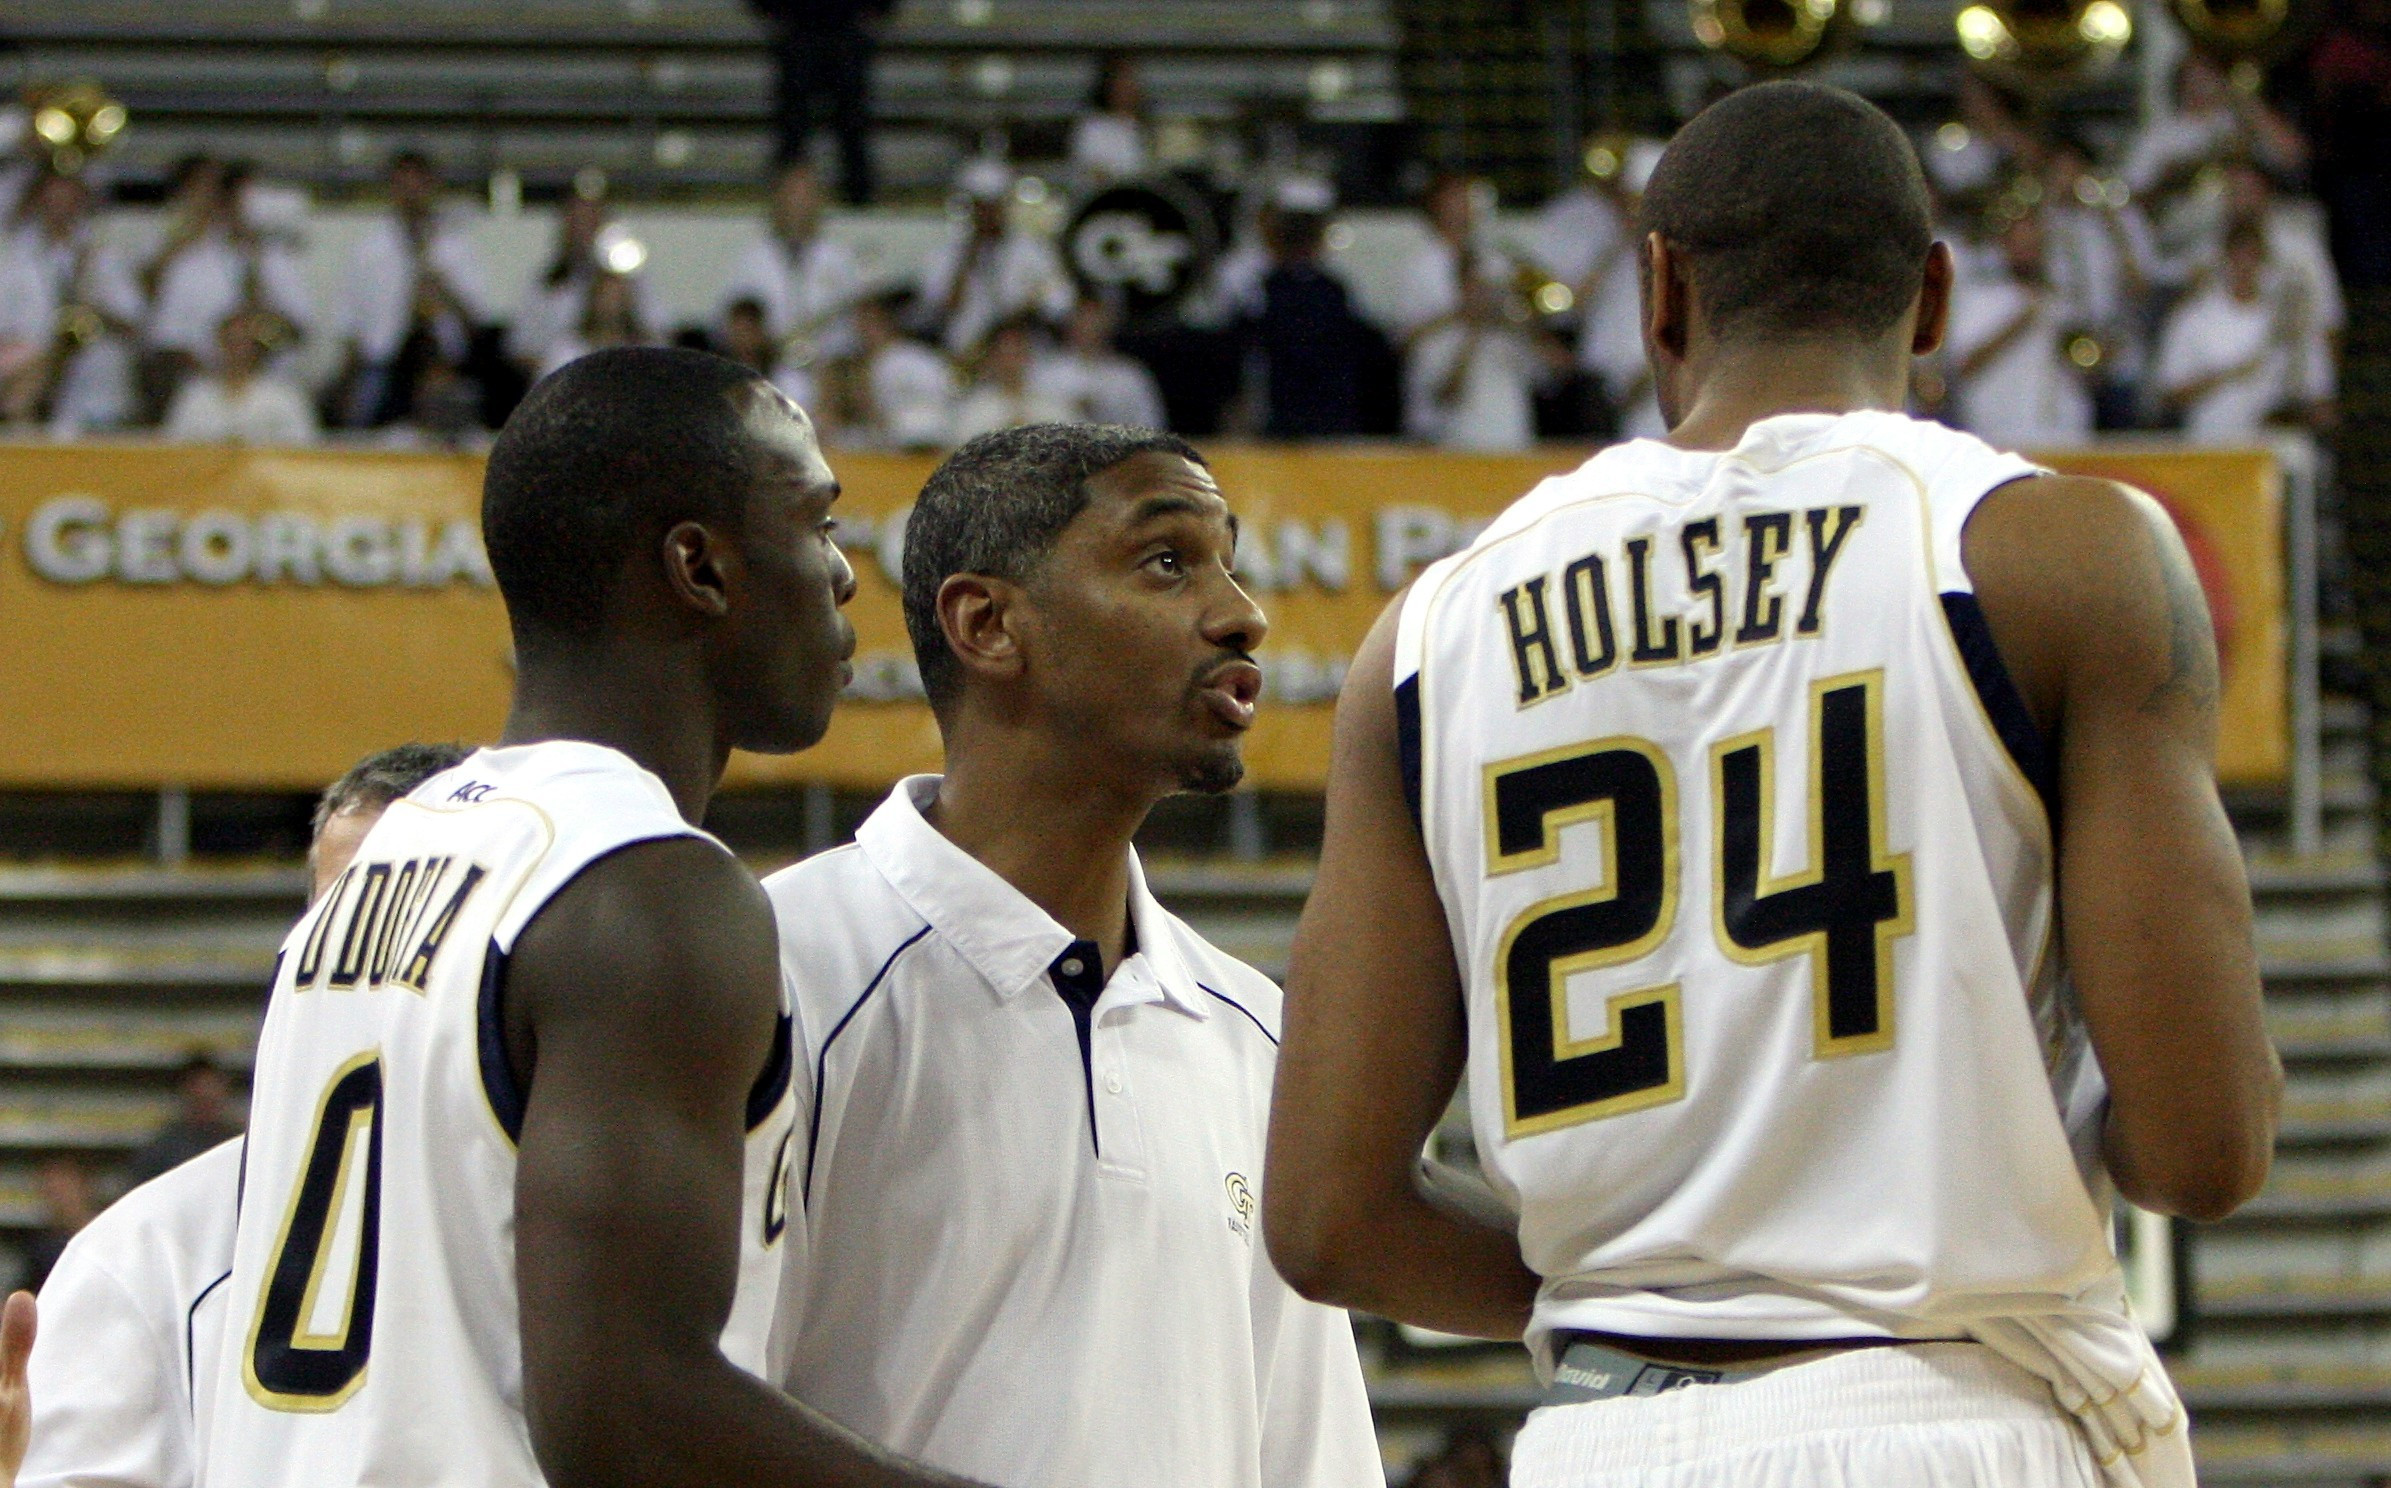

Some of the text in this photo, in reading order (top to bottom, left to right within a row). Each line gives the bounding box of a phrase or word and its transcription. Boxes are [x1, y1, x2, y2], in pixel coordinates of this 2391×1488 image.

[1498, 504, 1866, 712] HOLSEY
[1482, 667, 1916, 1142] 24
[242, 1041, 386, 1415] 0
